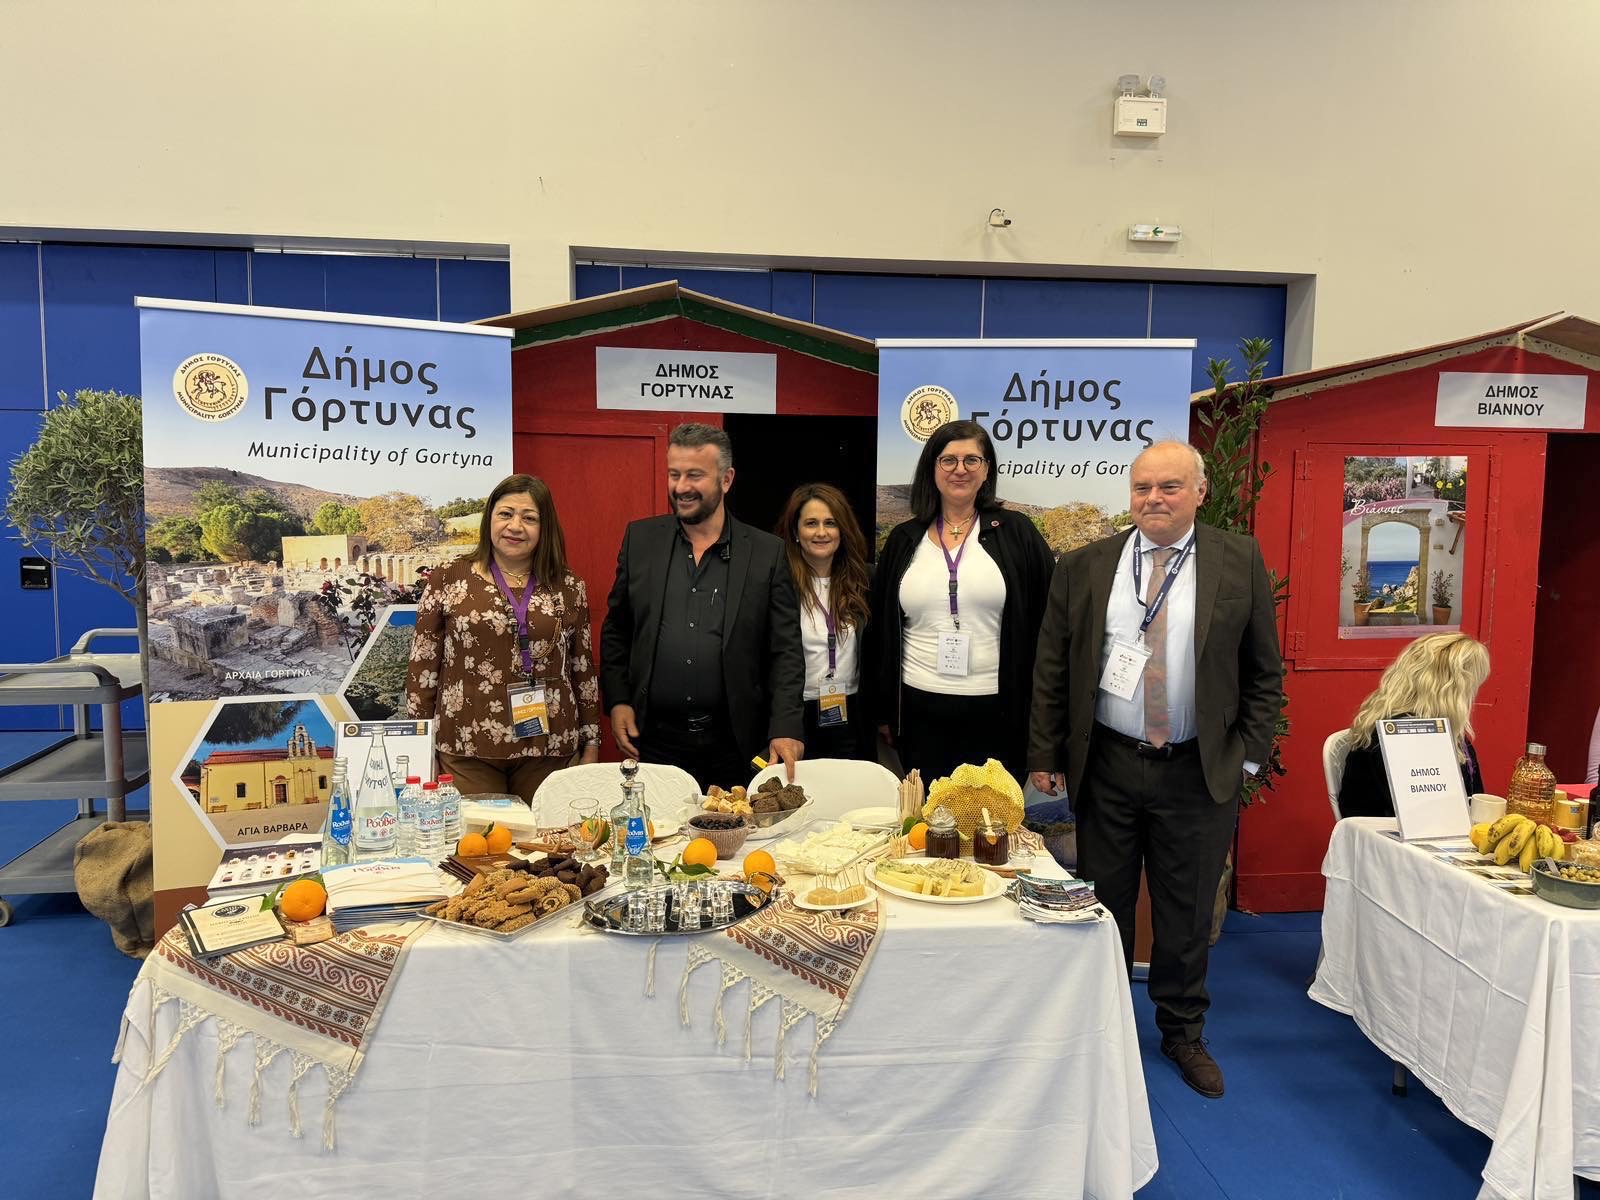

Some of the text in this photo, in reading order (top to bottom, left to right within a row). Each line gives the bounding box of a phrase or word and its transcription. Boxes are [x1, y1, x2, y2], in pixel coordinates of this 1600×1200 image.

[180, 355, 242, 377] ΔΗΜΟΣ ΓΟΡΤΥΝΑΣ
[302, 345, 439, 395] Δήμος
[656, 363, 719, 379] ΔΗΜΟΣ
[641, 382, 734, 400] ΓΟΡΤΥΝΑΣ
[1002, 369, 1122, 410] Δήμος
[1485, 385, 1539, 399] ΔΗΜΟΣ
[176, 391, 216, 420] MUNICIPALITY
[264, 385, 477, 439] Γόρτυνας
[1477, 402, 1545, 416] ΒΙΑΝΝΟΥ
[903, 419, 930, 442] MUNICIPALI
[248, 441, 493, 469] Municipality of Gortyna
[998, 460, 1066, 478] cipality
[1071, 460, 1091, 478] of
[225, 669, 312, 680] ΑΡΧΑΙΑ ΓΟΡΤΥΝΑ
[1410, 767, 1441, 777] ΔΗΜΟΣ
[1410, 783, 1447, 793] ΒΙΑΝΝΟΥ
[237, 822, 309, 837] ΑΓΙΑ ΒΑΡΒΑΡΑ
